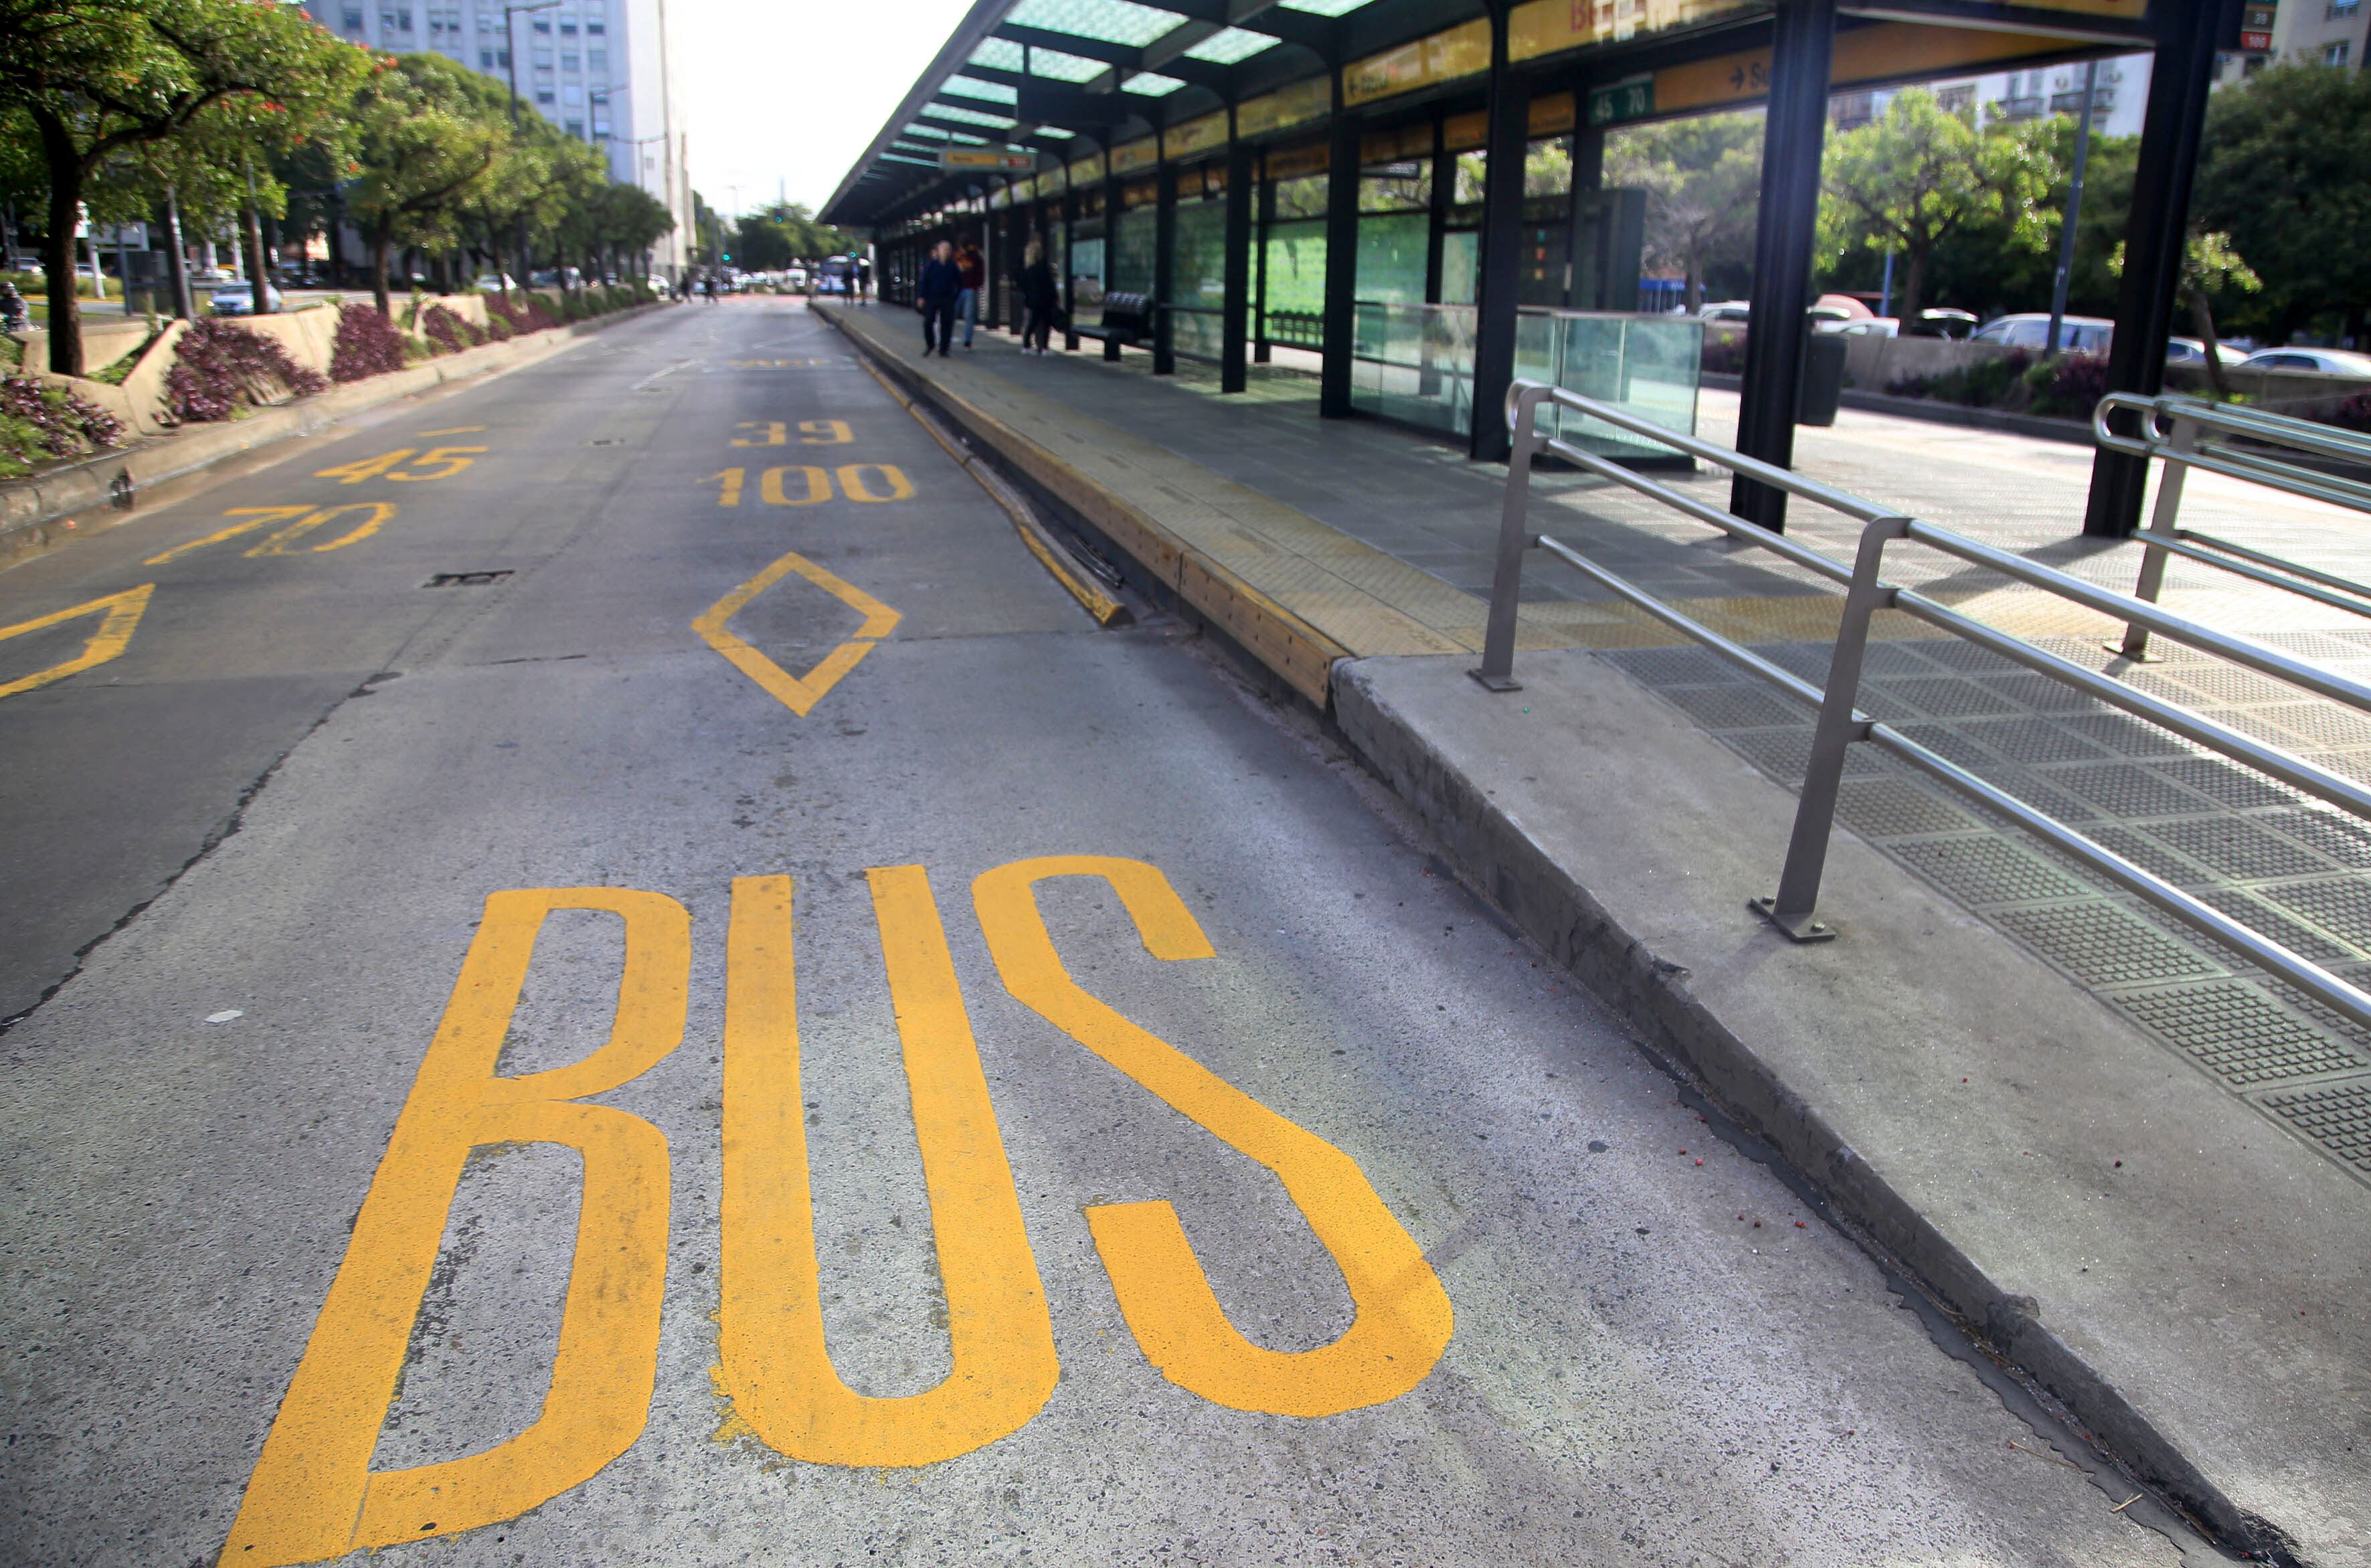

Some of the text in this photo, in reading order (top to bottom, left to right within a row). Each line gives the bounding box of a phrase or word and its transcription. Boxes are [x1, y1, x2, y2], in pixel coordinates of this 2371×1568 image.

[1629, 86, 1646, 114] 70
[730, 420, 855, 446] 39
[313, 448, 489, 484] 45
[697, 463, 916, 507] 100
[143, 502, 397, 565] 70
[216, 854, 1454, 1568] BUS
